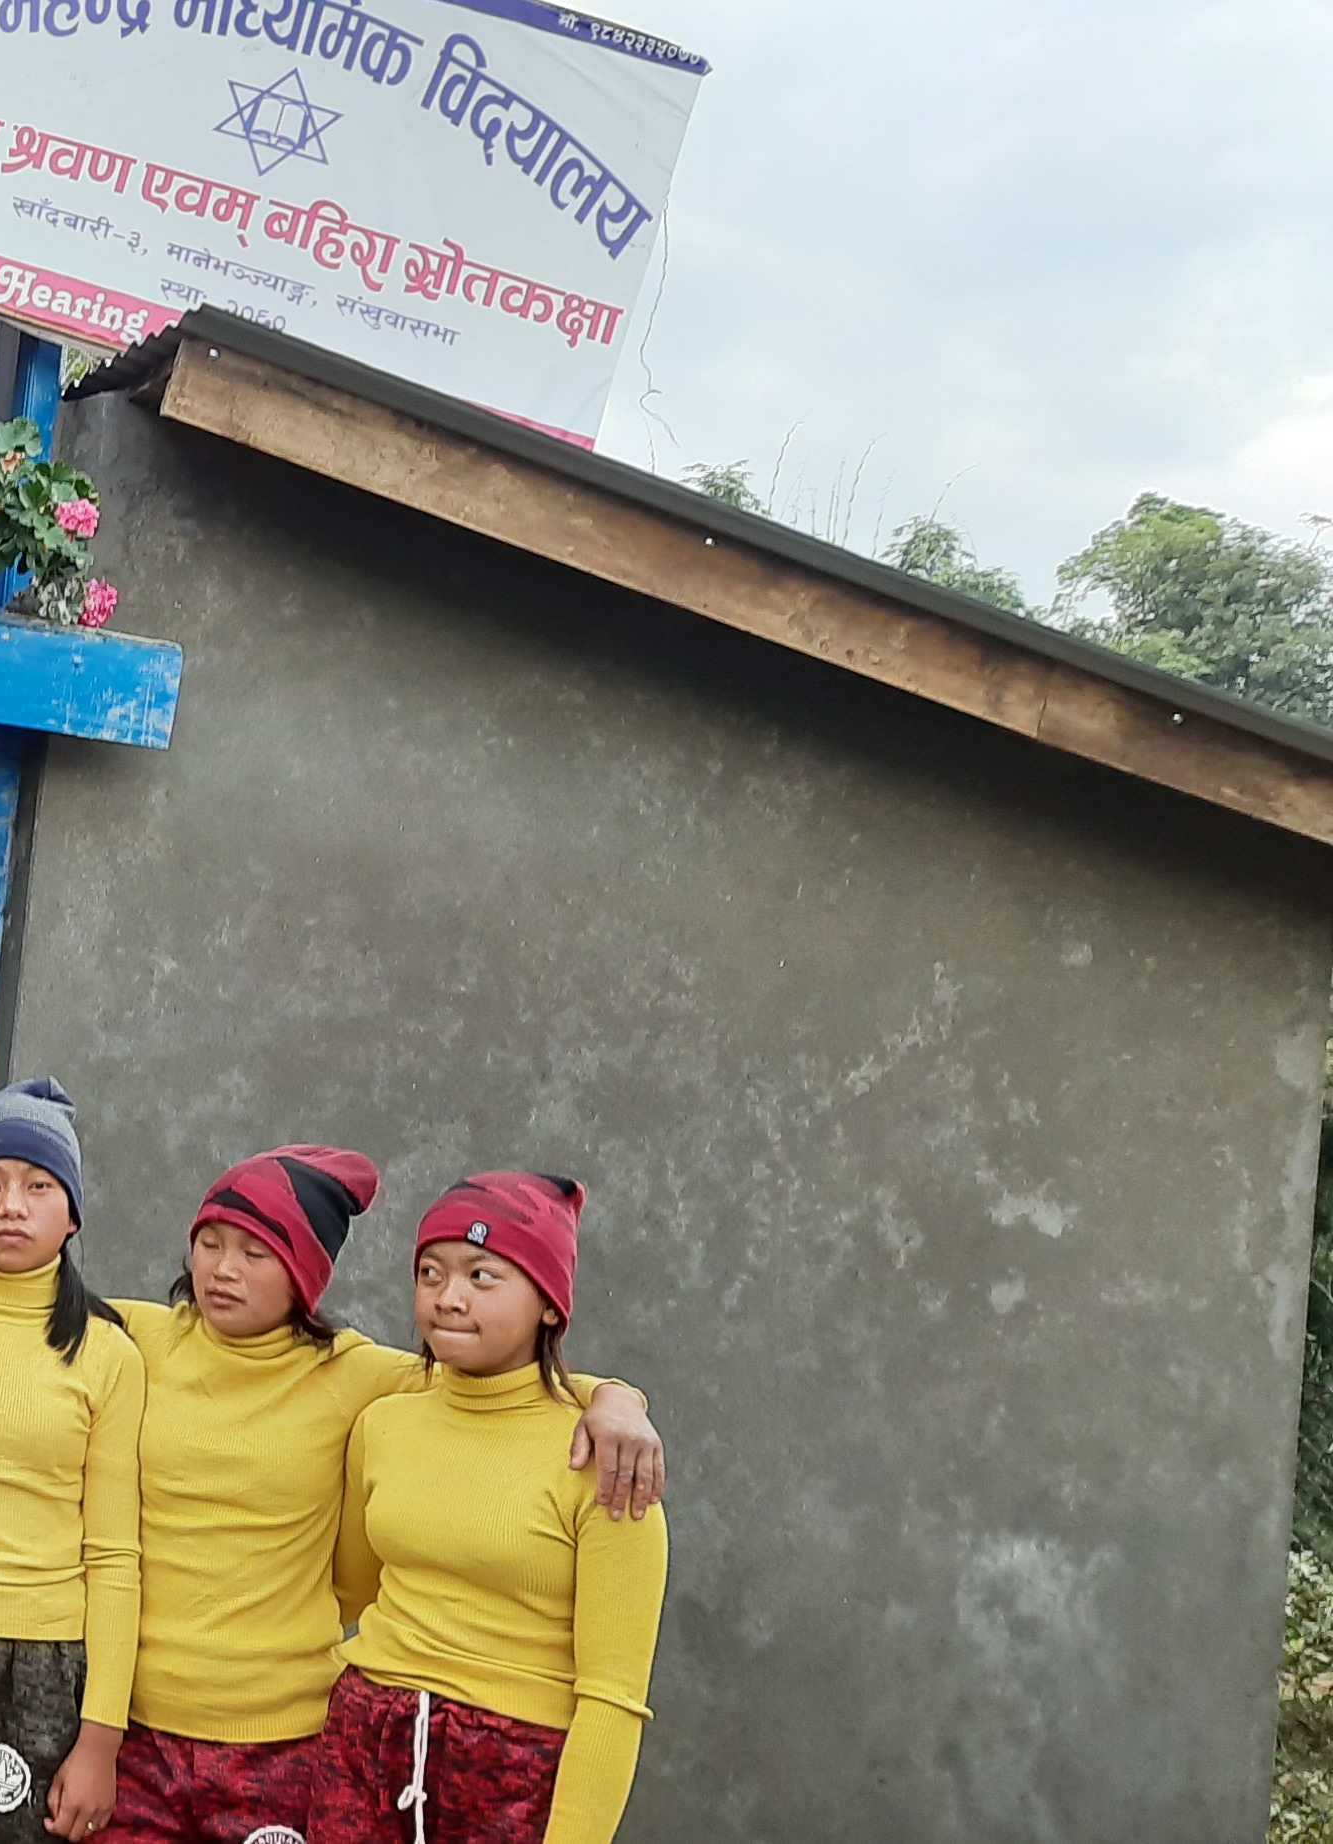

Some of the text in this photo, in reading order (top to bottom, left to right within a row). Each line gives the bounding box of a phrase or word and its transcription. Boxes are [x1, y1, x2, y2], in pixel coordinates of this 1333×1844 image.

[1, 124, 137, 194] श्रवण
[141, 162, 261, 248] एवम्
[264, 199, 400, 292] बहिरा
[404, 237, 624, 348] स्रोतकक्षा
[336, 294, 461, 346] संखुवासभा
